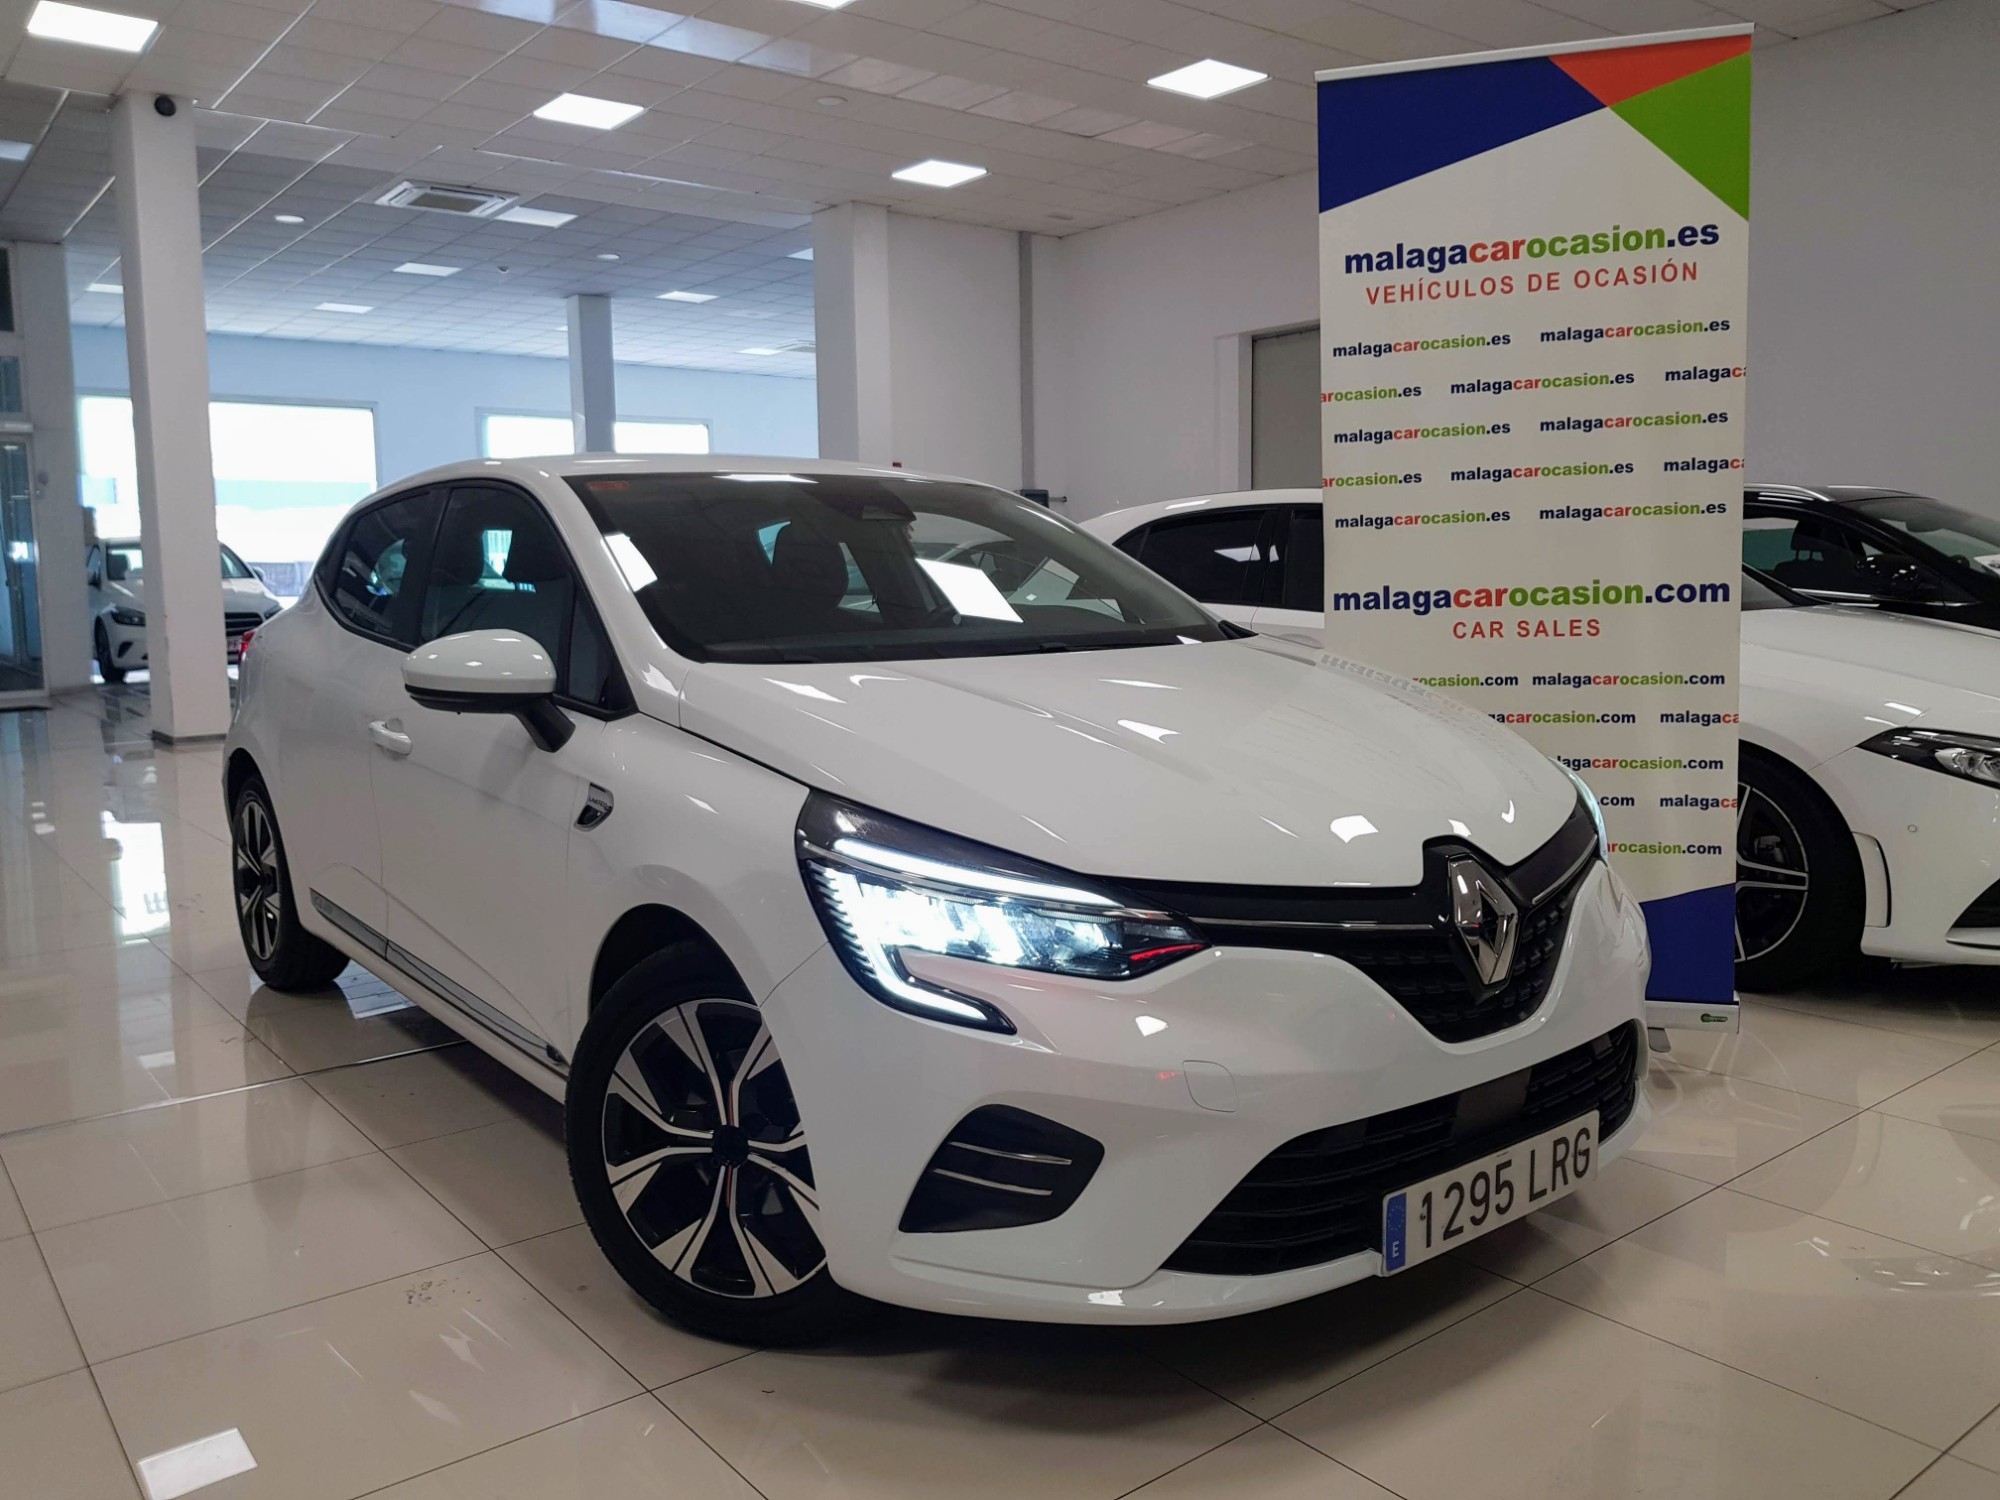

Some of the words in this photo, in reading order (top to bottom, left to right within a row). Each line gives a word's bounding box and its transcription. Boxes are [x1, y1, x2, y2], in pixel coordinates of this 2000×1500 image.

[1344, 224, 1720, 275] malagacarocasion.es
[1365, 275, 1514, 305] VEHÍCULOS
[1527, 271, 1561, 293] DE
[1573, 258, 1698, 289] OCASIÓN
[1332, 333, 1511, 358] malagacarocasion.es
[1540, 318, 1731, 343] malagacarocasion.es
[1450, 372, 1635, 396] malagacarocasion.es
[1665, 366, 1746, 382] malagac
[1333, 422, 1511, 444] malagacarocasion.es
[1539, 410, 1729, 433] malagacarocasion.es
[1450, 461, 1634, 483] malagacarocasion.es
[1663, 457, 1744, 473] malagac
[1334, 509, 1511, 530] malagacarocasion.es
[1539, 501, 1727, 521] malagacarocasion.es
[1333, 579, 1731, 616] malagacarocasion.com
[1452, 620, 1505, 639] CAR
[1516, 618, 1601, 638] SALES
[1412, 673, 1519, 687] ocasion.com
[1532, 671, 1726, 689] malagacarocasion.com
[1421, 1159, 1515, 1249] 1295
[1528, 1127, 1591, 1203] LRG
[1392, 1240, 1400, 1258] E
